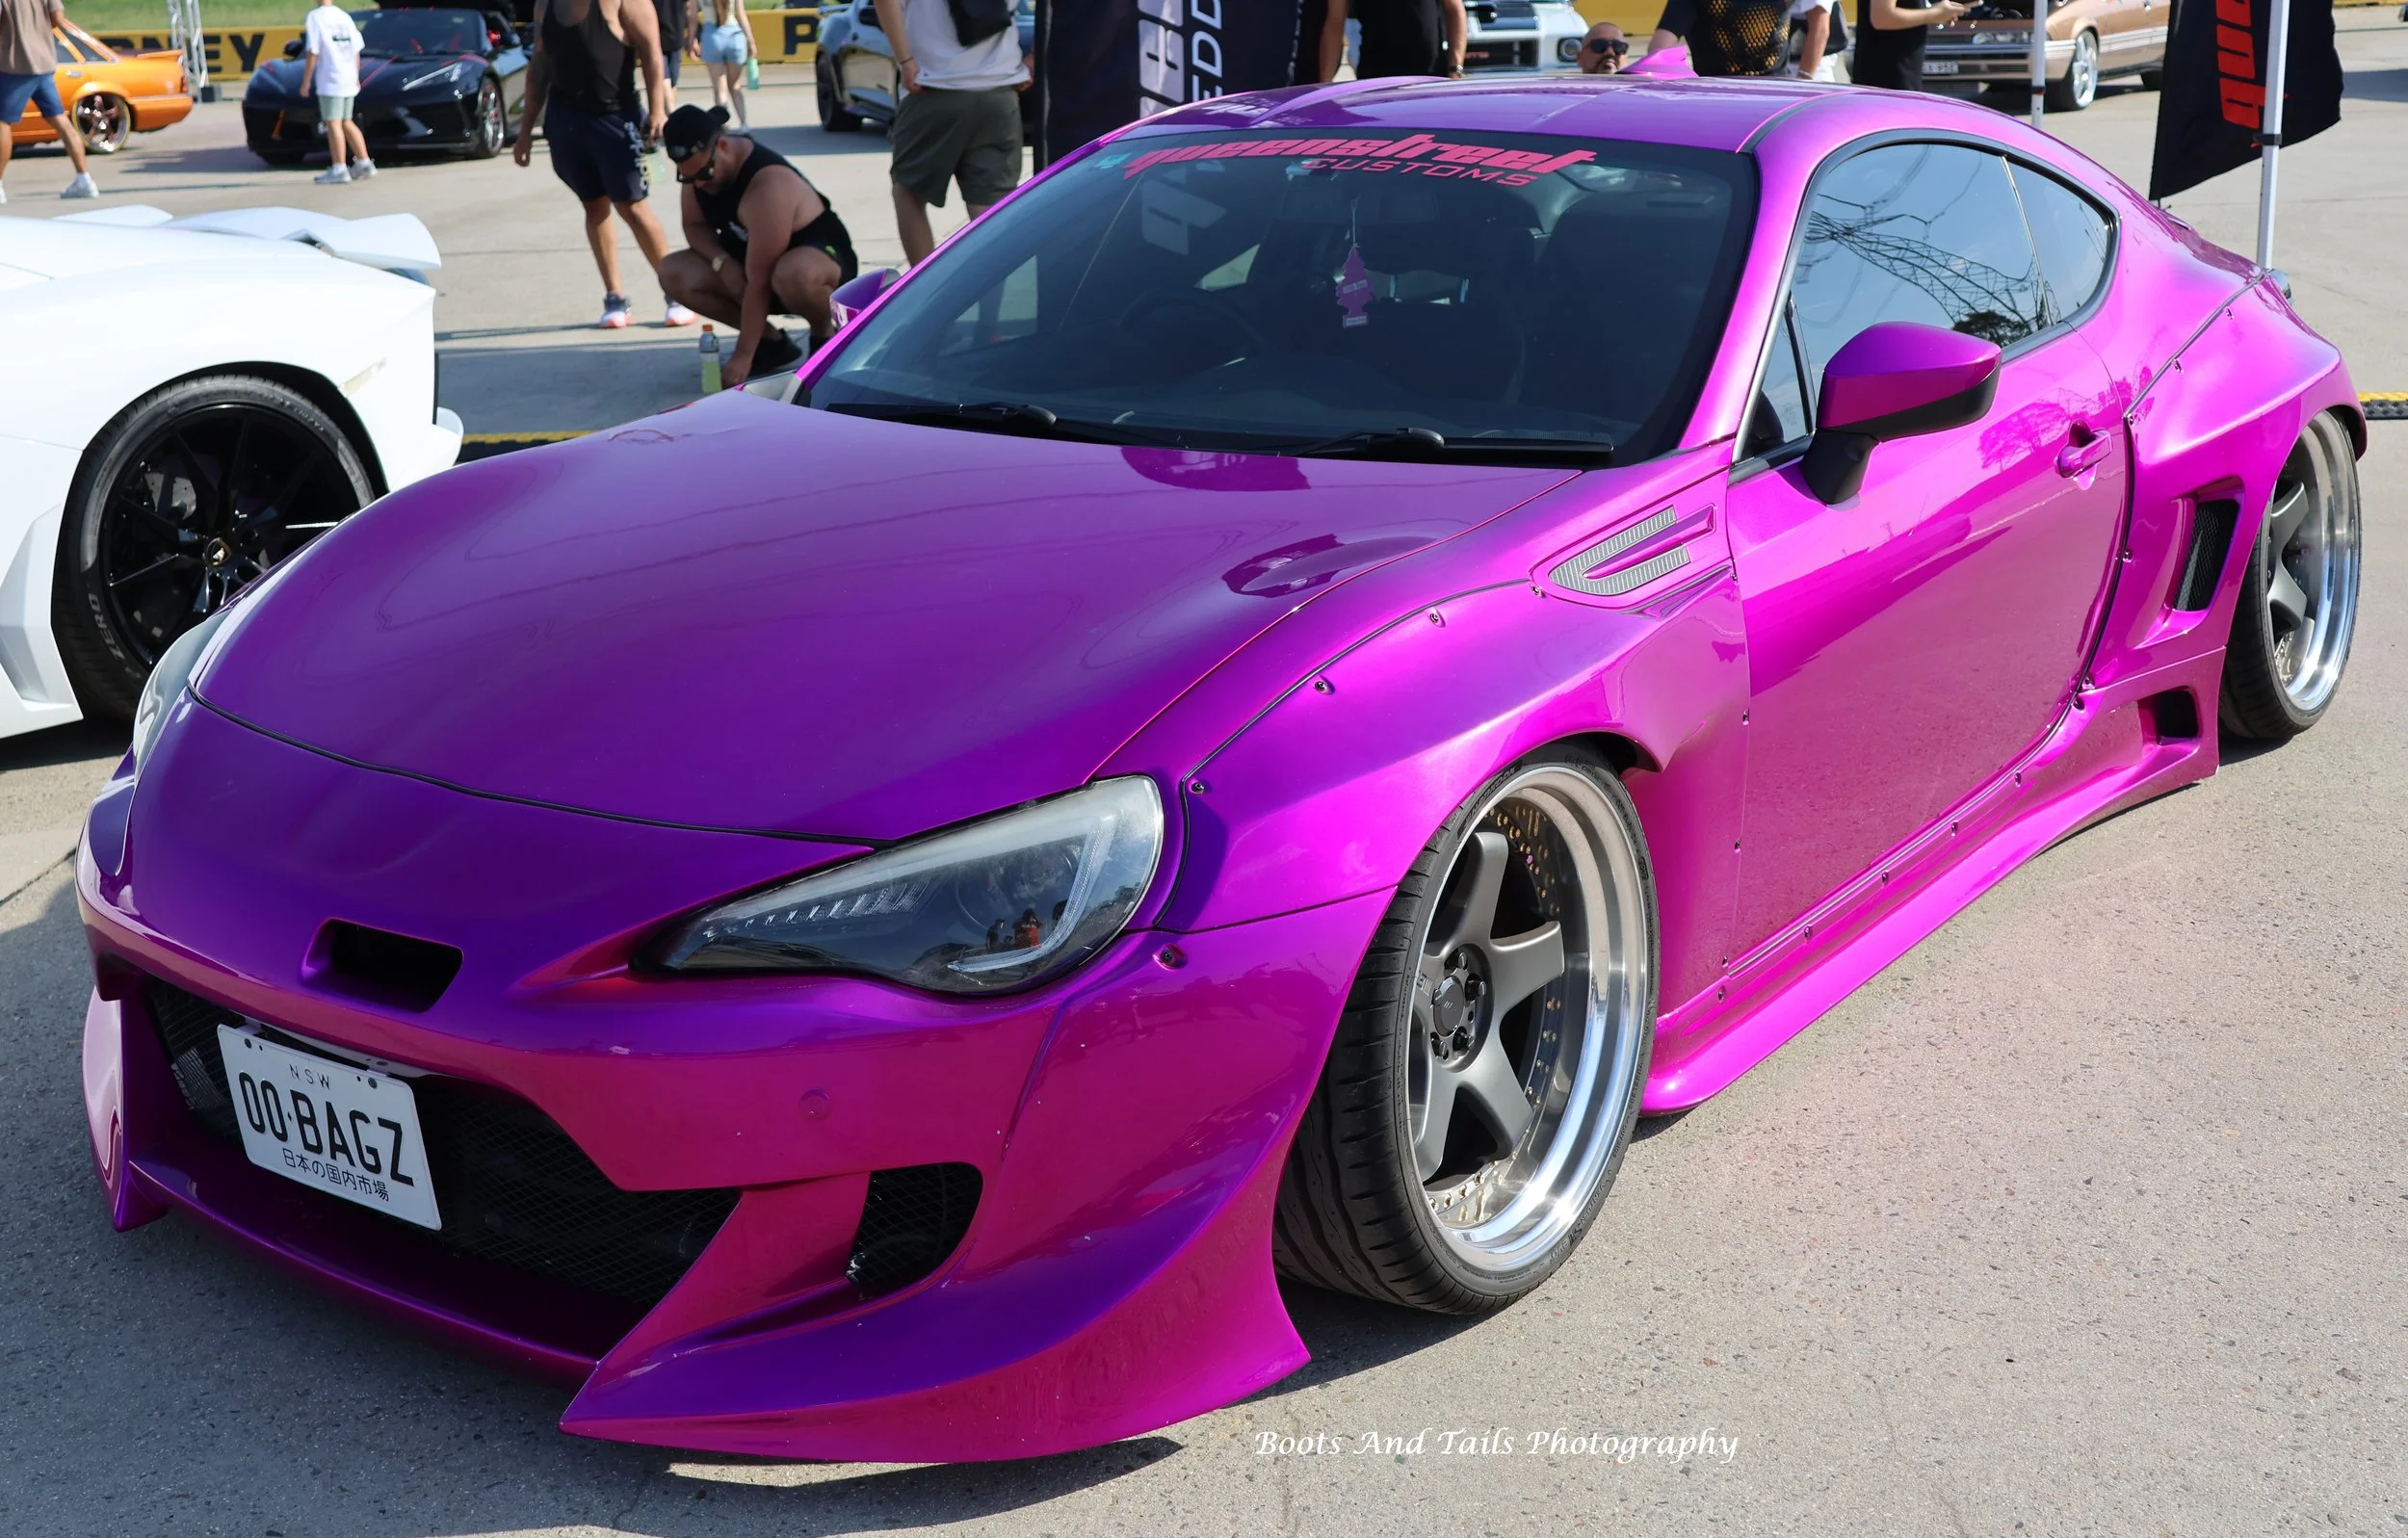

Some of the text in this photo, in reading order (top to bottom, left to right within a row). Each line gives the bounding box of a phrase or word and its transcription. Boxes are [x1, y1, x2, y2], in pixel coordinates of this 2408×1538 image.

[1301, 157, 1538, 187] CUSTOMS
[290, 1064, 331, 1090] NSW
[282, 1147, 390, 1203] 日本の国内市場
